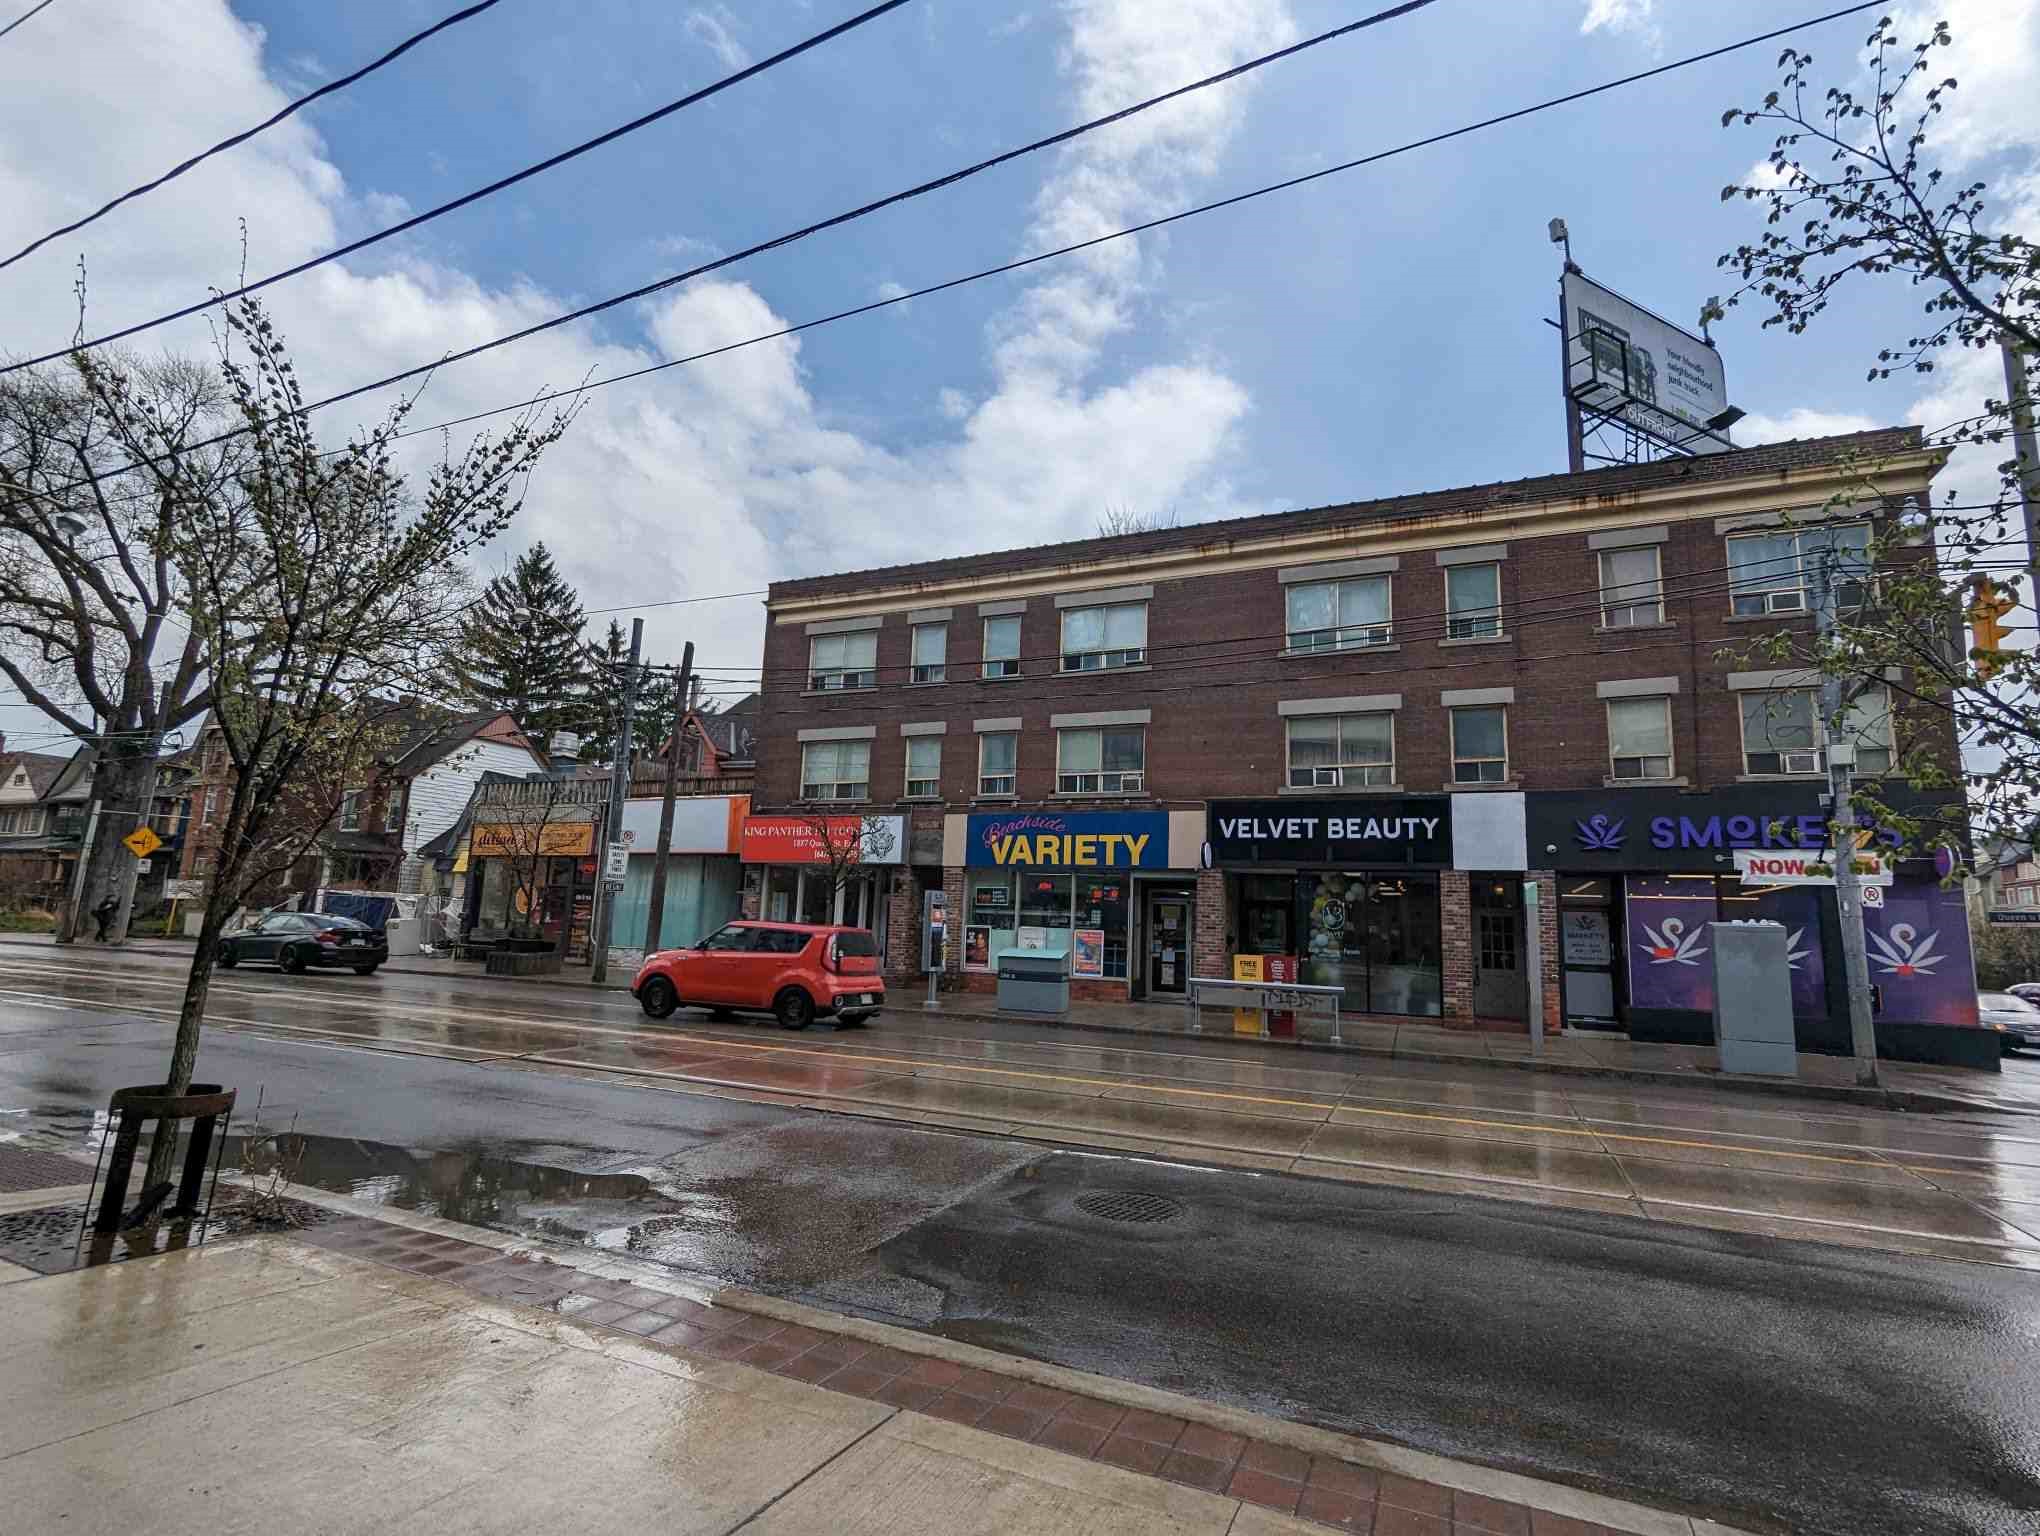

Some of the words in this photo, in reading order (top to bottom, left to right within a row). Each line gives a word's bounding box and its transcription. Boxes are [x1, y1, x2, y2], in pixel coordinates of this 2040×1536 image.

[744, 825, 767, 837] KING
[768, 824, 813, 837] PANTHER
[982, 815, 1071, 849] Beachside
[1219, 817, 1319, 839] VELVET
[1327, 817, 1439, 840] BEAUTY
[991, 833, 1150, 866] VARIETY
[1749, 858, 1806, 876] NOW
